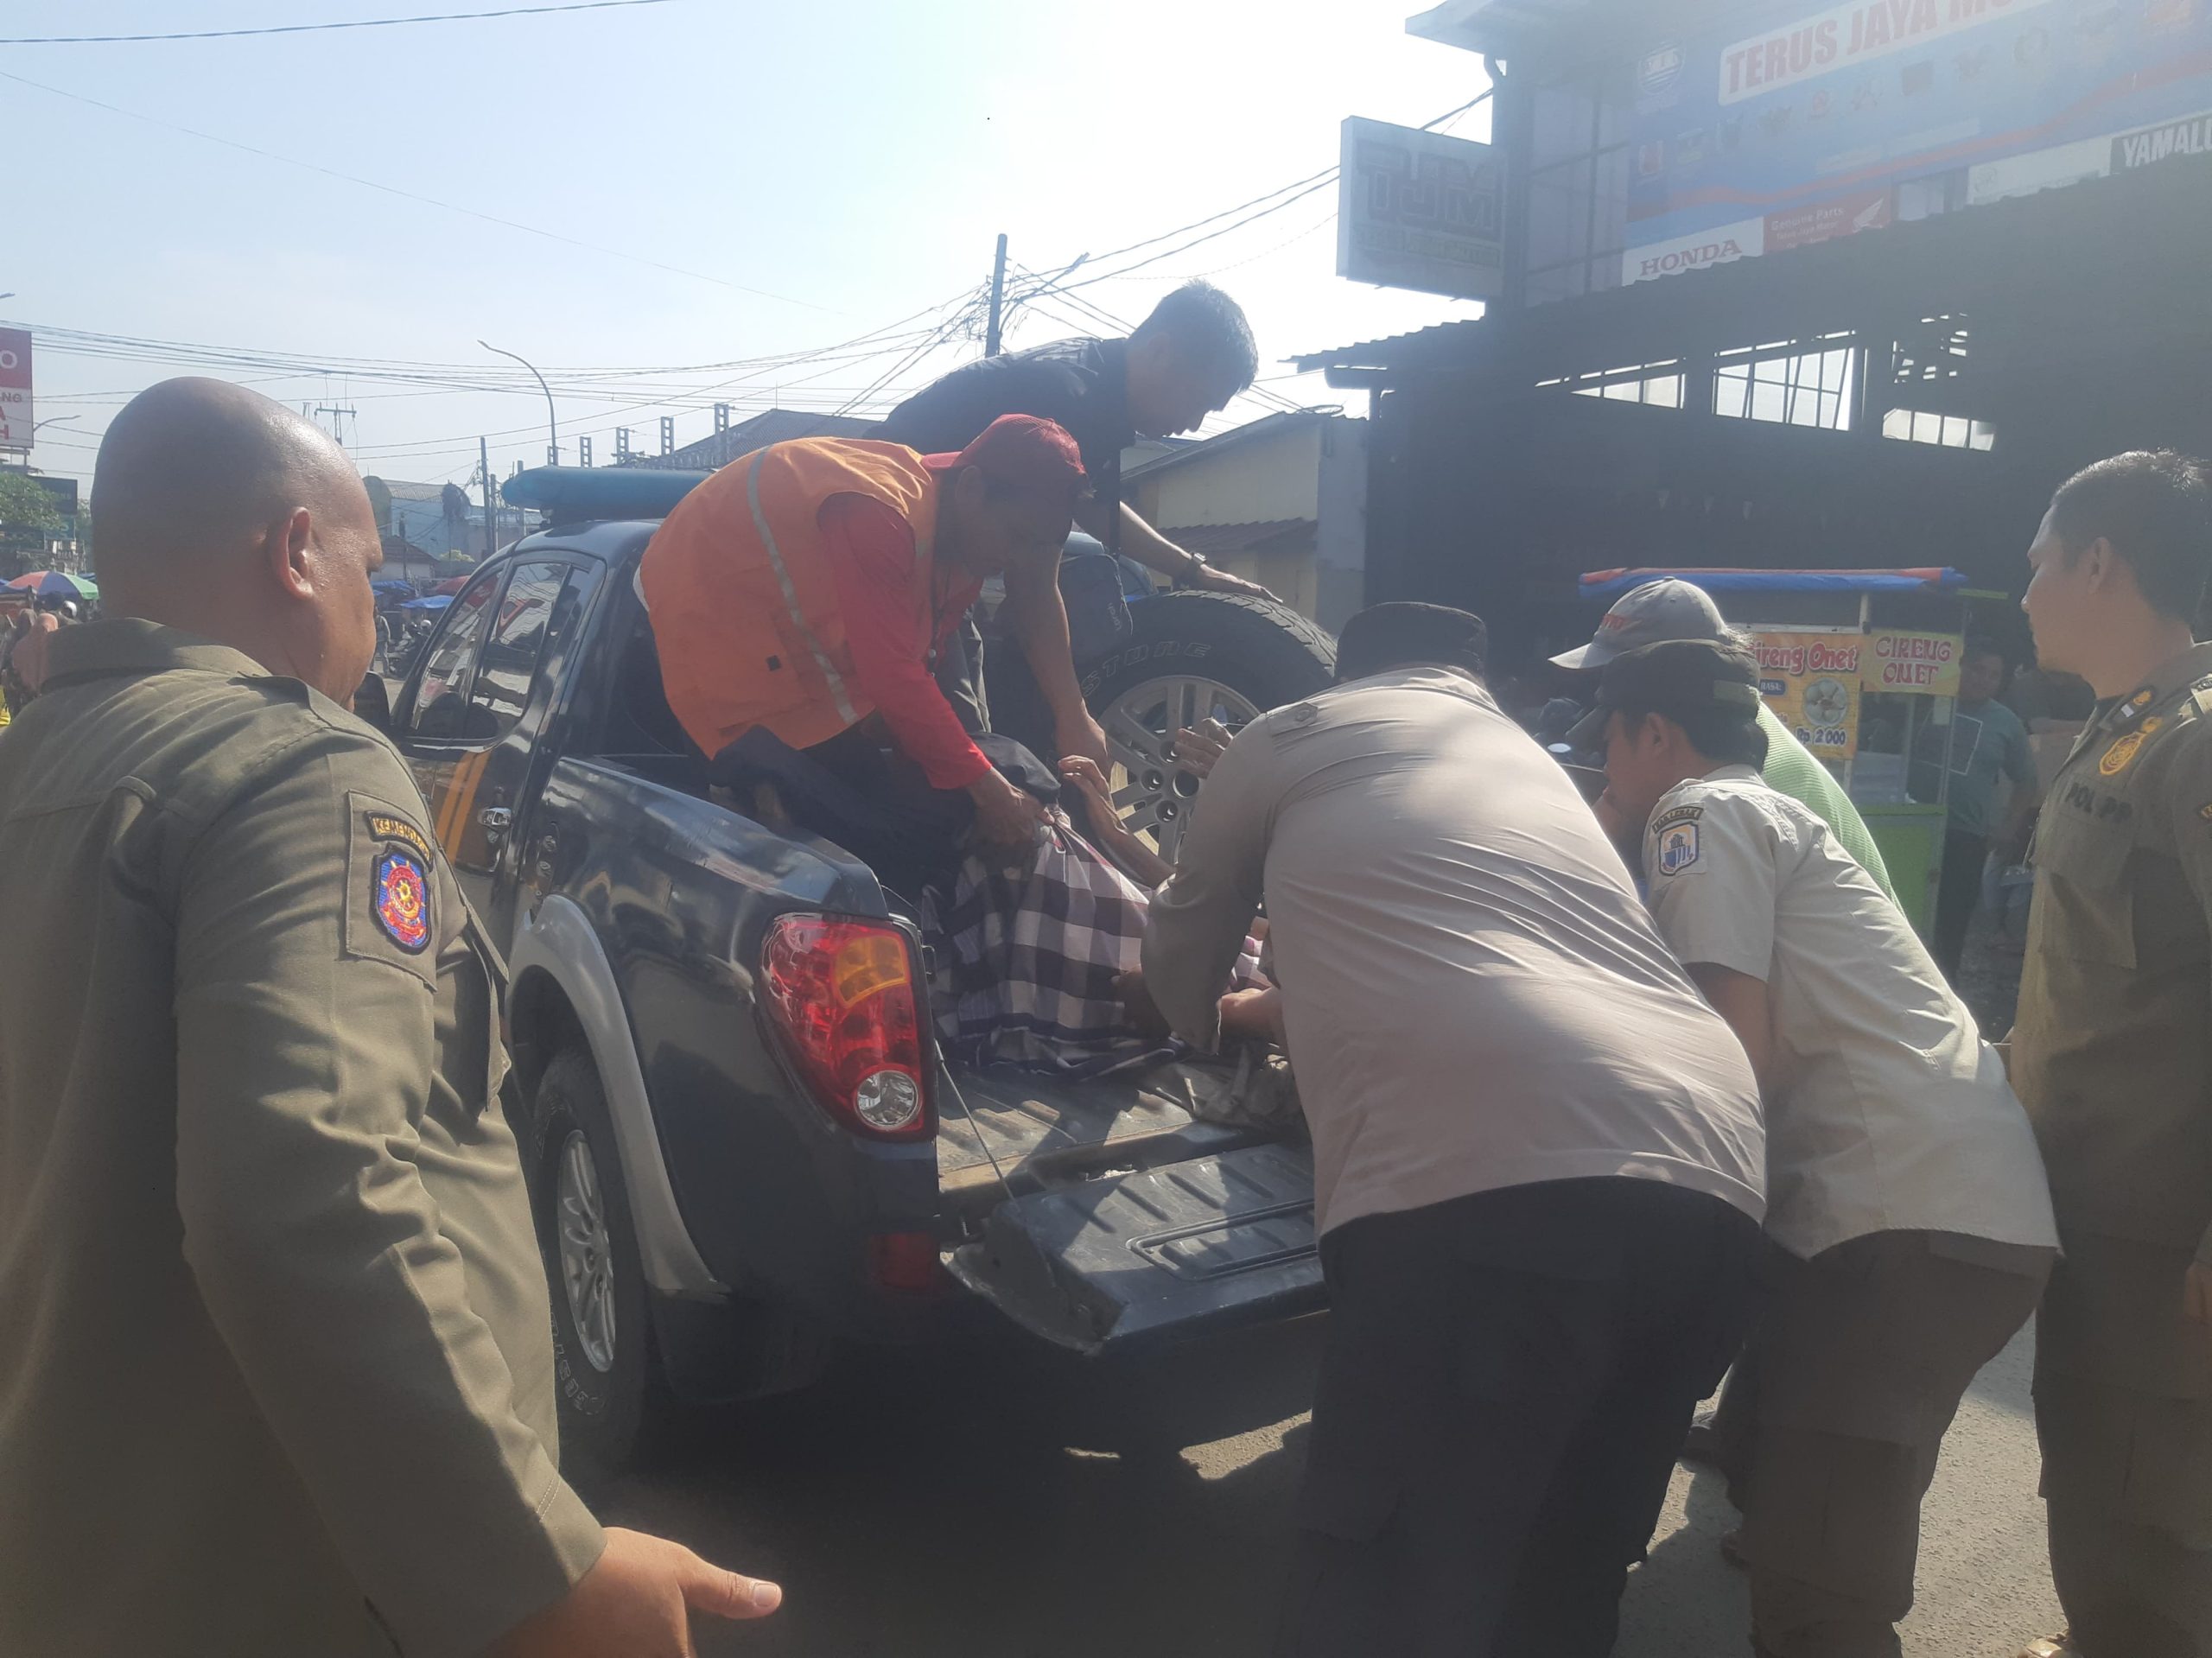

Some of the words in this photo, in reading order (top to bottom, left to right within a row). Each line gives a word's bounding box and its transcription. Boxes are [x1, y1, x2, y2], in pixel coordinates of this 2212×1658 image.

[1726, 19, 1838, 94] TERUS
[1846, 0, 1936, 54] JAYA
[1639, 238, 1743, 276] HONDA
[0, 392, 22, 403] NG
[1081, 640, 1211, 697] STONE
[1751, 641, 1805, 675] ireng
[1808, 642, 1858, 671] Onet
[1882, 662, 1940, 686] ONET
[1796, 727, 1810, 745] Rp
[373, 817, 430, 860] KEMENDA
